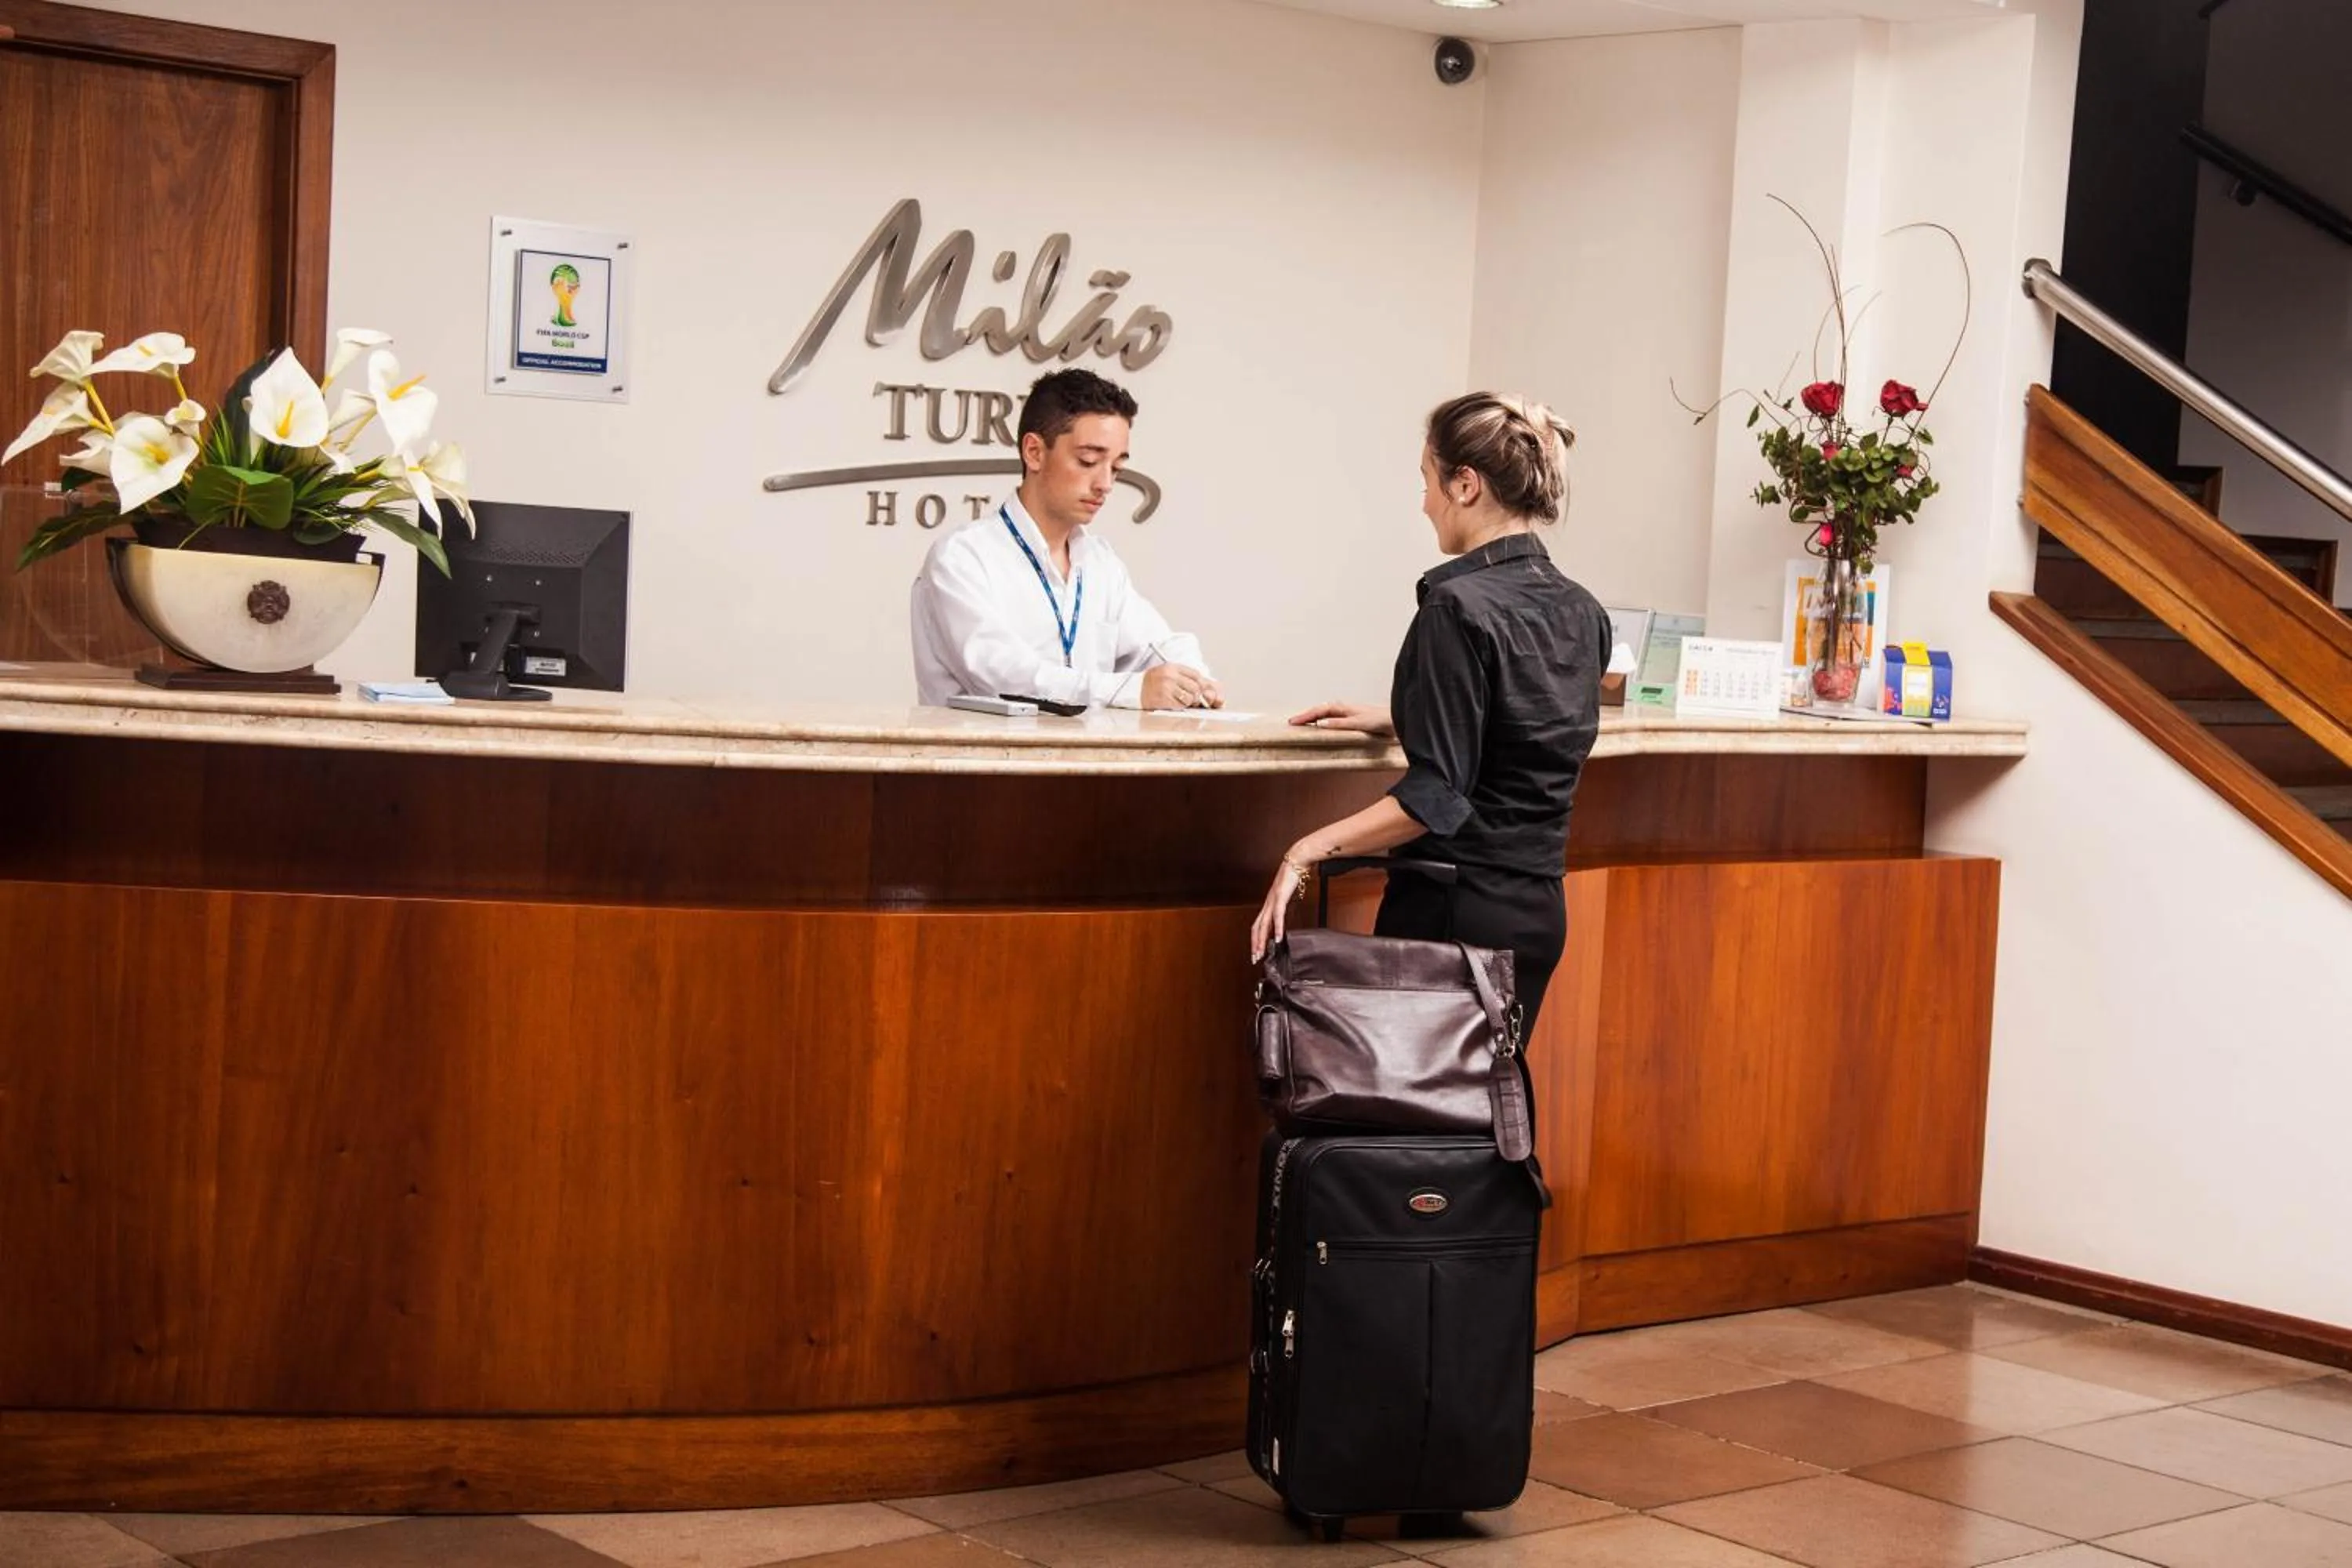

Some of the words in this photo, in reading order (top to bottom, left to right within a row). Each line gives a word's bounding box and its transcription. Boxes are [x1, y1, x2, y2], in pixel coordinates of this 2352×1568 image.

[768, 198, 1173, 394] Milão
[873, 381, 1029, 447] TUR
[866, 490, 990, 528] HOT
